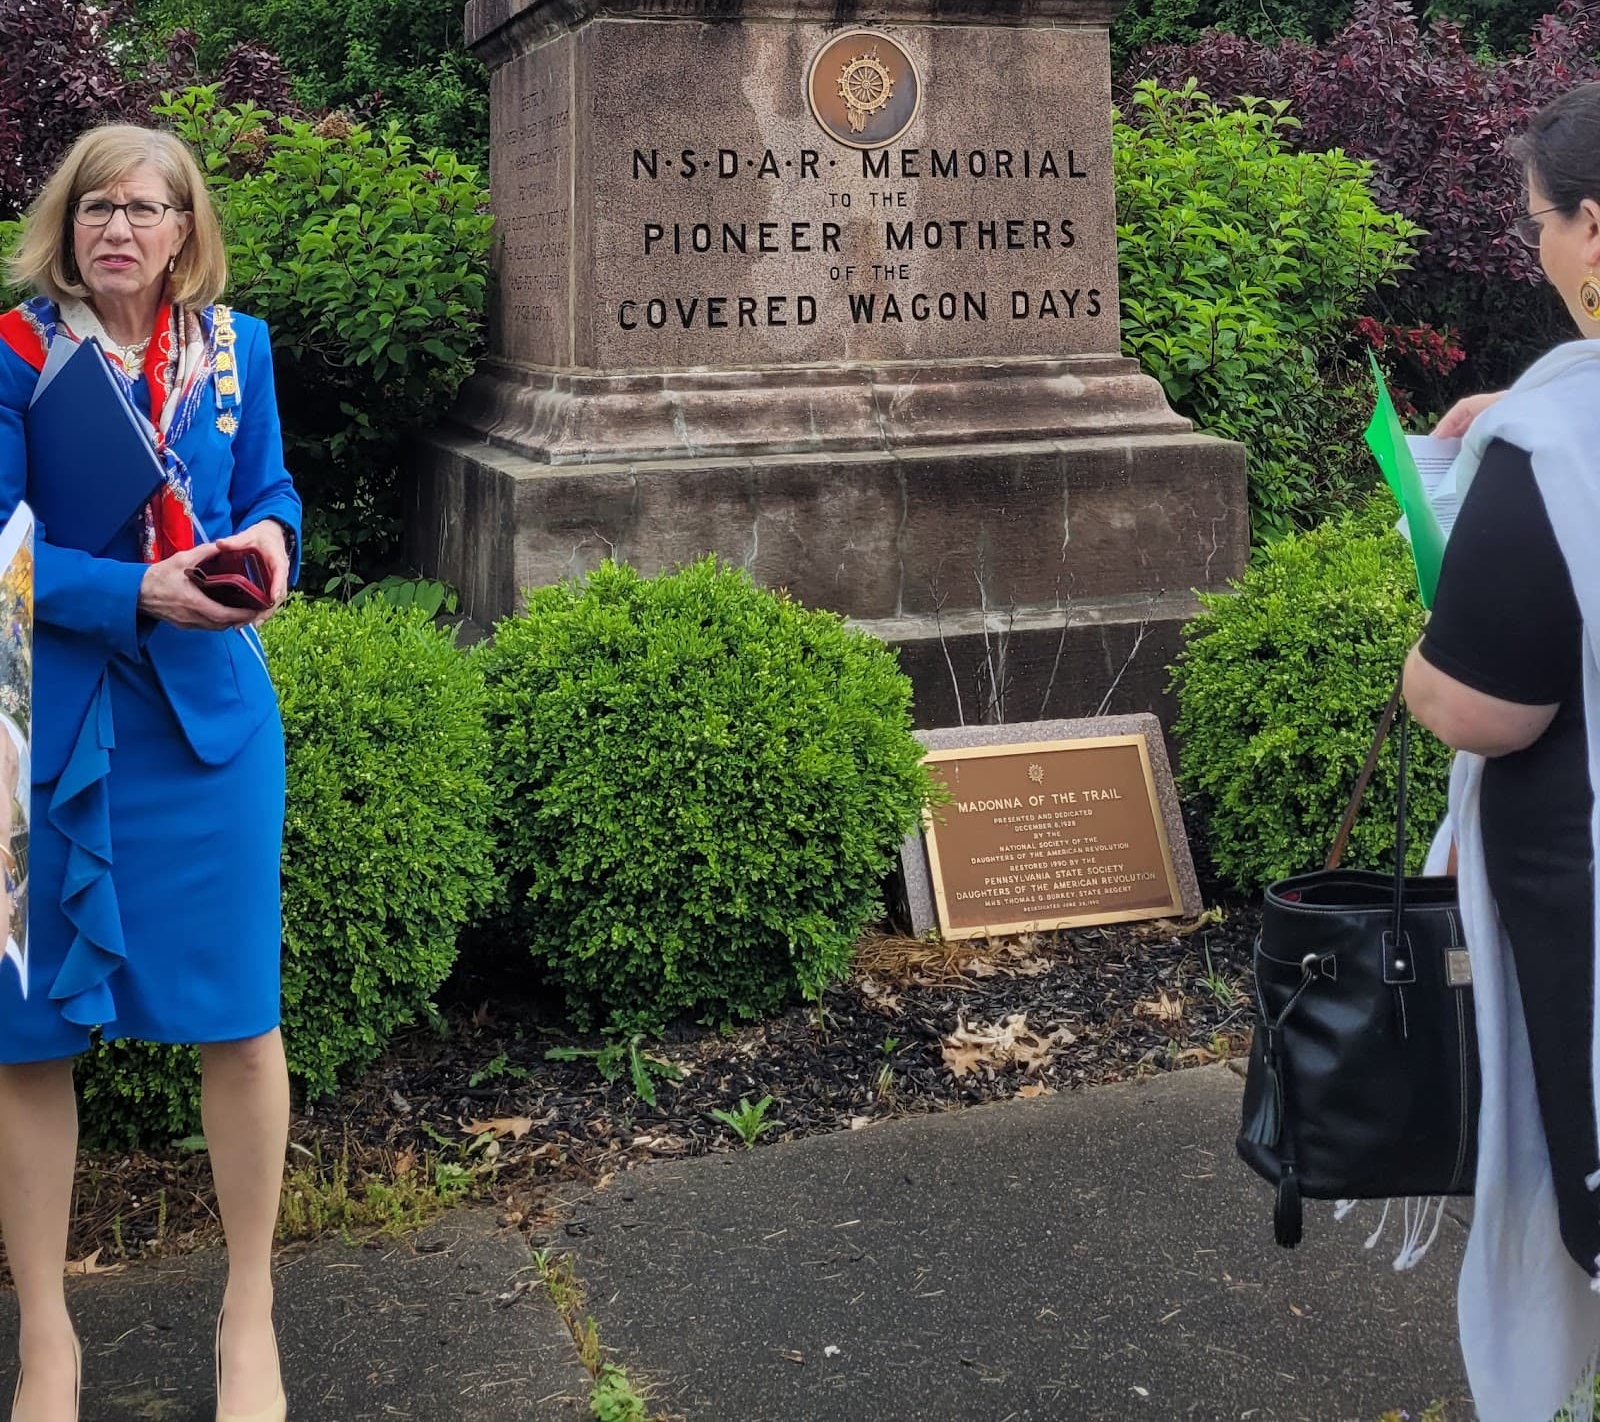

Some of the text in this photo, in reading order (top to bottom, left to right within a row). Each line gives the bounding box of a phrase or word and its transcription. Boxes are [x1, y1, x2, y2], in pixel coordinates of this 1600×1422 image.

[862, 149, 1087, 178] MEMORIAL
[829, 192, 907, 208] TO THE
[643, 219, 1075, 255] PIONEER MOTHERS
[830, 264, 910, 281] OF THE
[617, 288, 1101, 331] COVERED WAGON DAYS
[958, 788, 1122, 813] MADONNA OF THE TRAIL
[993, 809, 1093, 824] PRESENTED AND DEDICATED
[1014, 822, 1053, 832] DECEMBER
[1033, 830, 1062, 840] BY THE
[1000, 836, 1098, 852] NATIONAL SOCIETY OF THE
[970, 842, 1129, 865] DAUGHTERS OF THE AMERICAN REVOLUTION
[1010, 862, 1048, 872] RESTORED
[1082, 857, 1097, 865] THE
[984, 864, 1124, 886] PENNSYLVANIA STATE SOCIETY
[956, 872, 1156, 900] DAUGHTERS OF THE AMERICAN REVOLUTION
[1004, 895, 1036, 904] THOMAS
[1079, 888, 1101, 897] STATE
